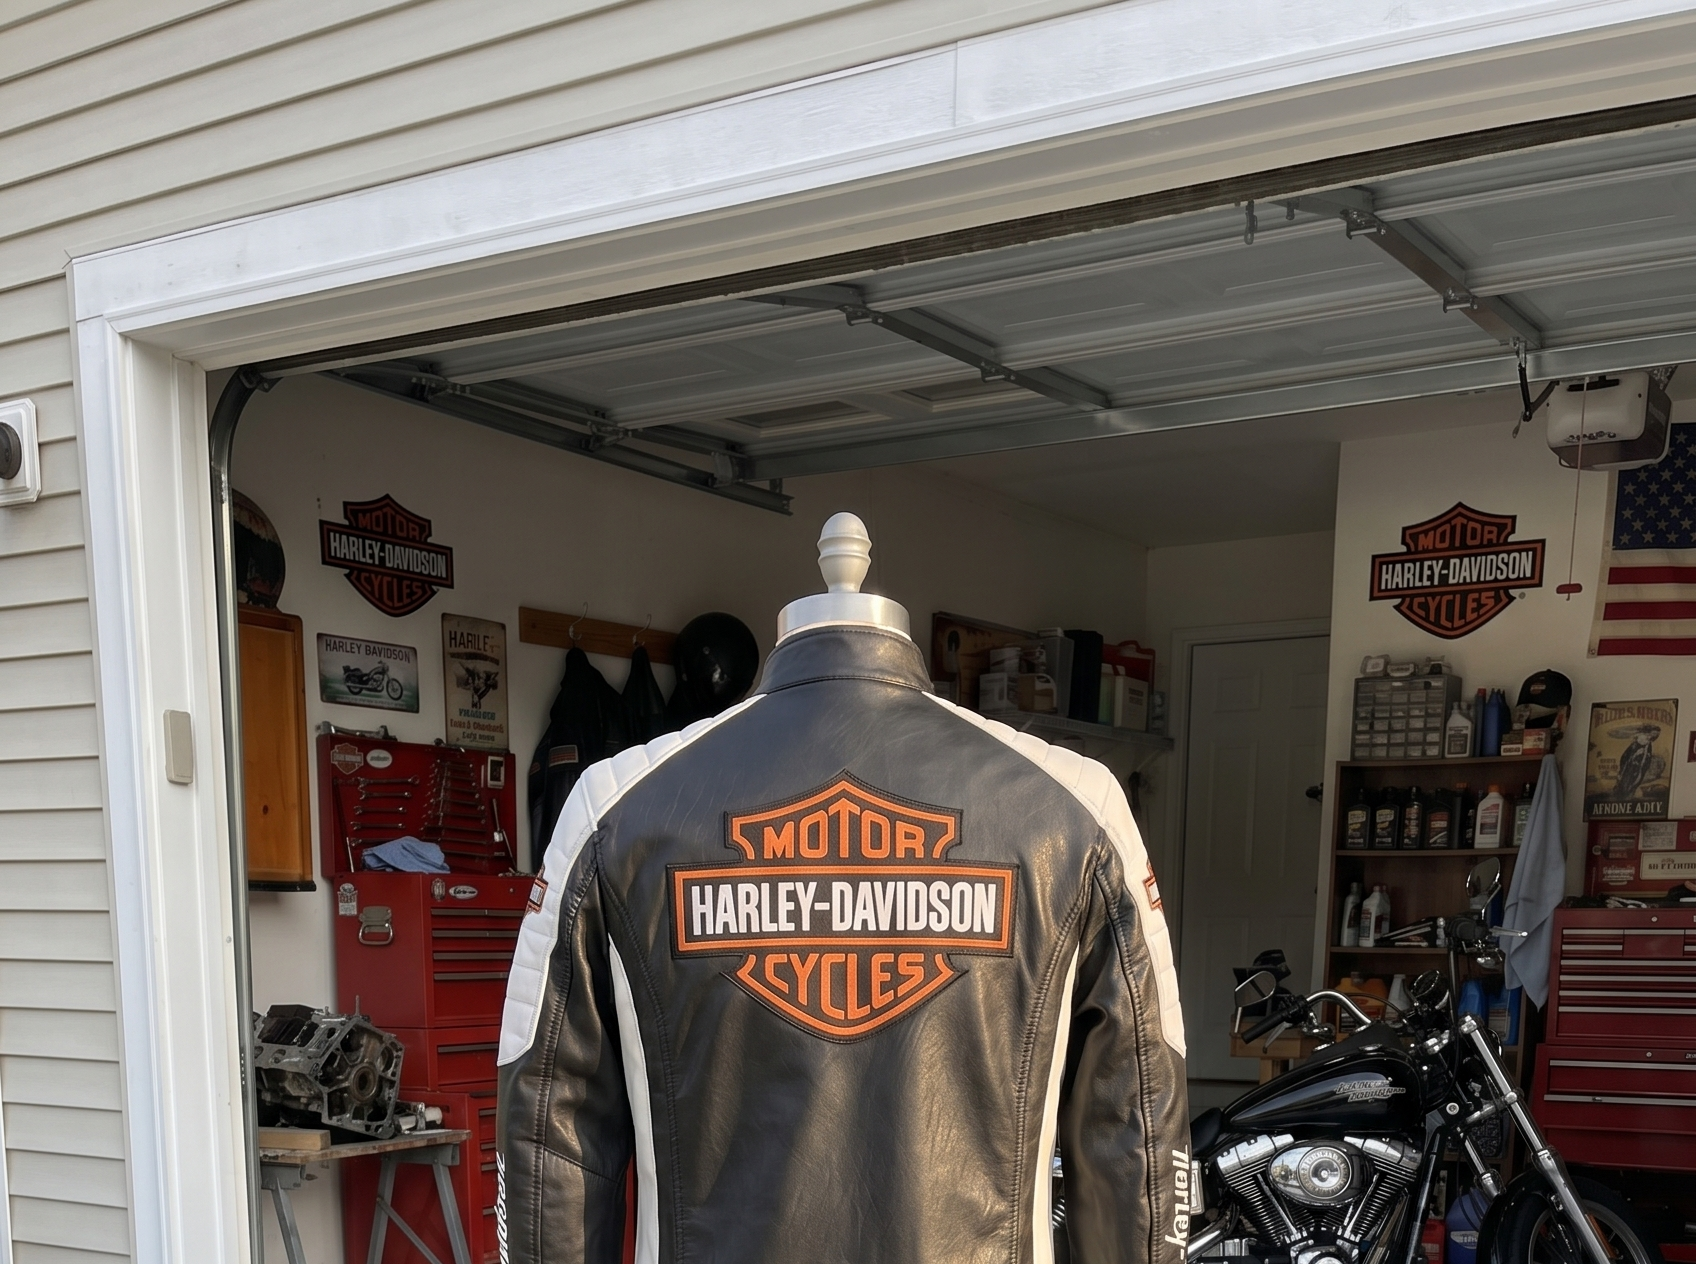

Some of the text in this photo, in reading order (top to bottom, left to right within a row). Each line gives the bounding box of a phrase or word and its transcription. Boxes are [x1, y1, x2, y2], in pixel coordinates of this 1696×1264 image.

[358, 506, 420, 541] MOTOR
[1418, 516, 1498, 550] MOTOR
[329, 531, 447, 578] HARLEY-DAVIDSON
[1381, 551, 1533, 590] HARLEY-DAVIDSON
[361, 572, 423, 607] CYCLES
[1412, 591, 1495, 628] CYCLES
[325, 639, 362, 654] HARLEY
[763, 798, 925, 859] MOTOR
[691, 881, 997, 936] HARLEY-DAVIDSON
[764, 953, 925, 1020] CYCLES
